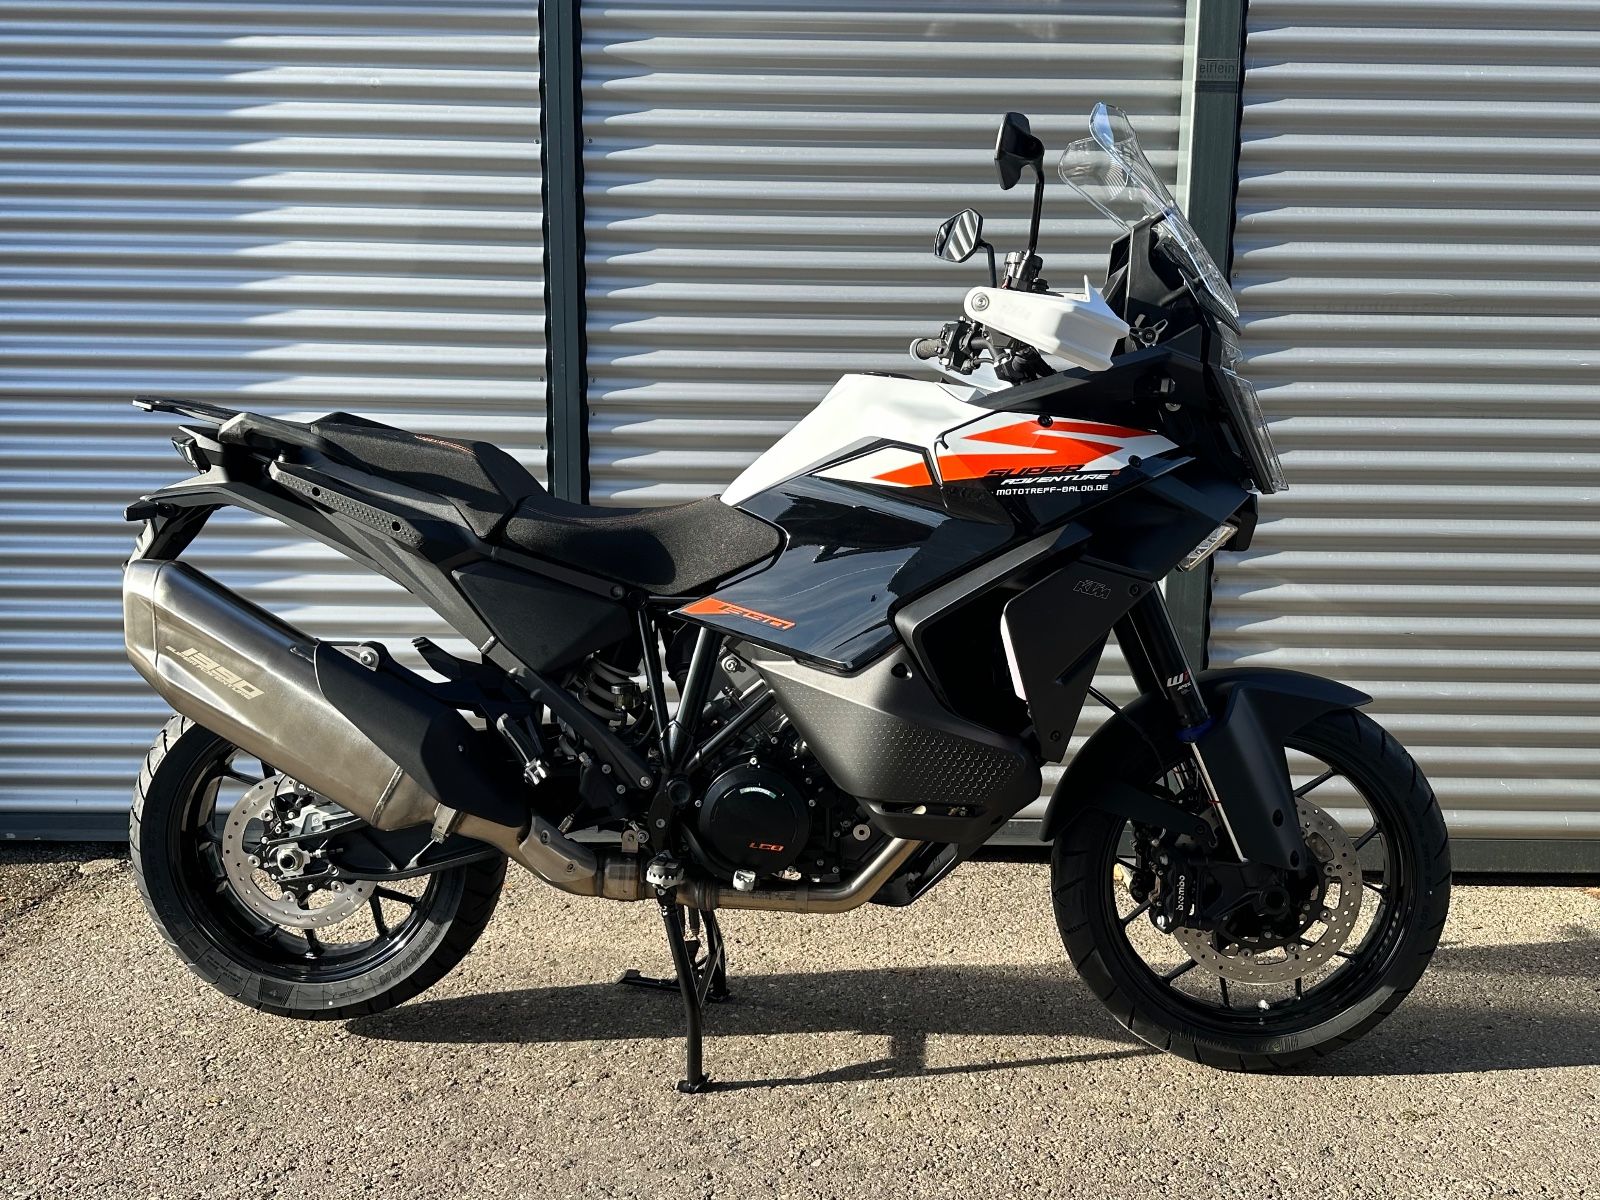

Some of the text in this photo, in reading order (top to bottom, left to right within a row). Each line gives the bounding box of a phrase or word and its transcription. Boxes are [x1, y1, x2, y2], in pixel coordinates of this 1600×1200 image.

[986, 464, 1086, 477] SUPER
[1001, 473, 1111, 486] ADVENTURE
[996, 484, 1109, 496] MOTOTREFF-BALOG.DE
